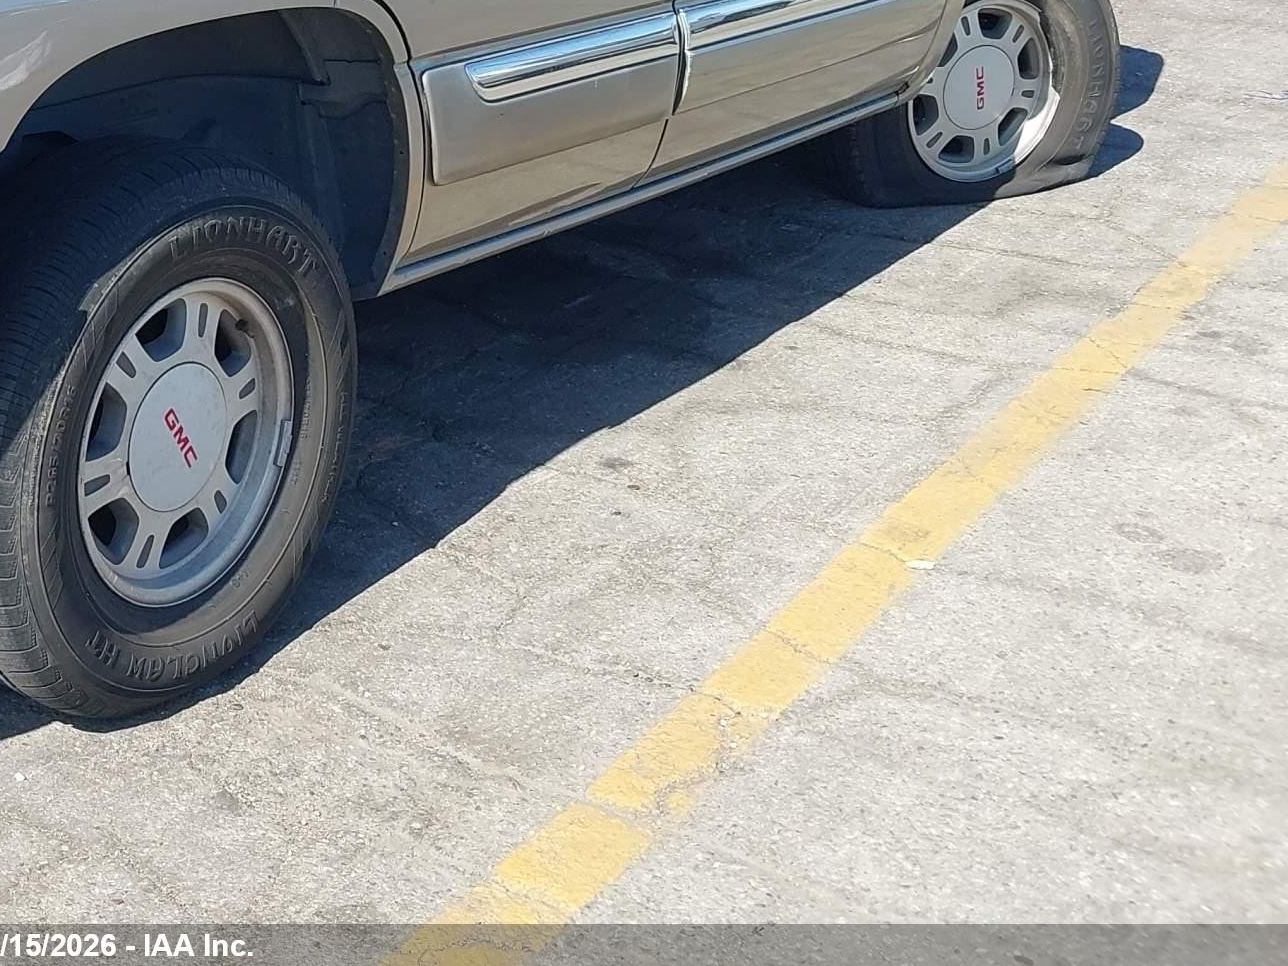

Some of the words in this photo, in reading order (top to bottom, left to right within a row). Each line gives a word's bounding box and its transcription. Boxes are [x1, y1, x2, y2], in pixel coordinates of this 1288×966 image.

[976, 65, 985, 111] GMC
[167, 215, 320, 276] LIONHART
[164, 407, 199, 469] GMC
[84, 629, 121, 667] HT
[125, 609, 258, 683] LIONCLAW
